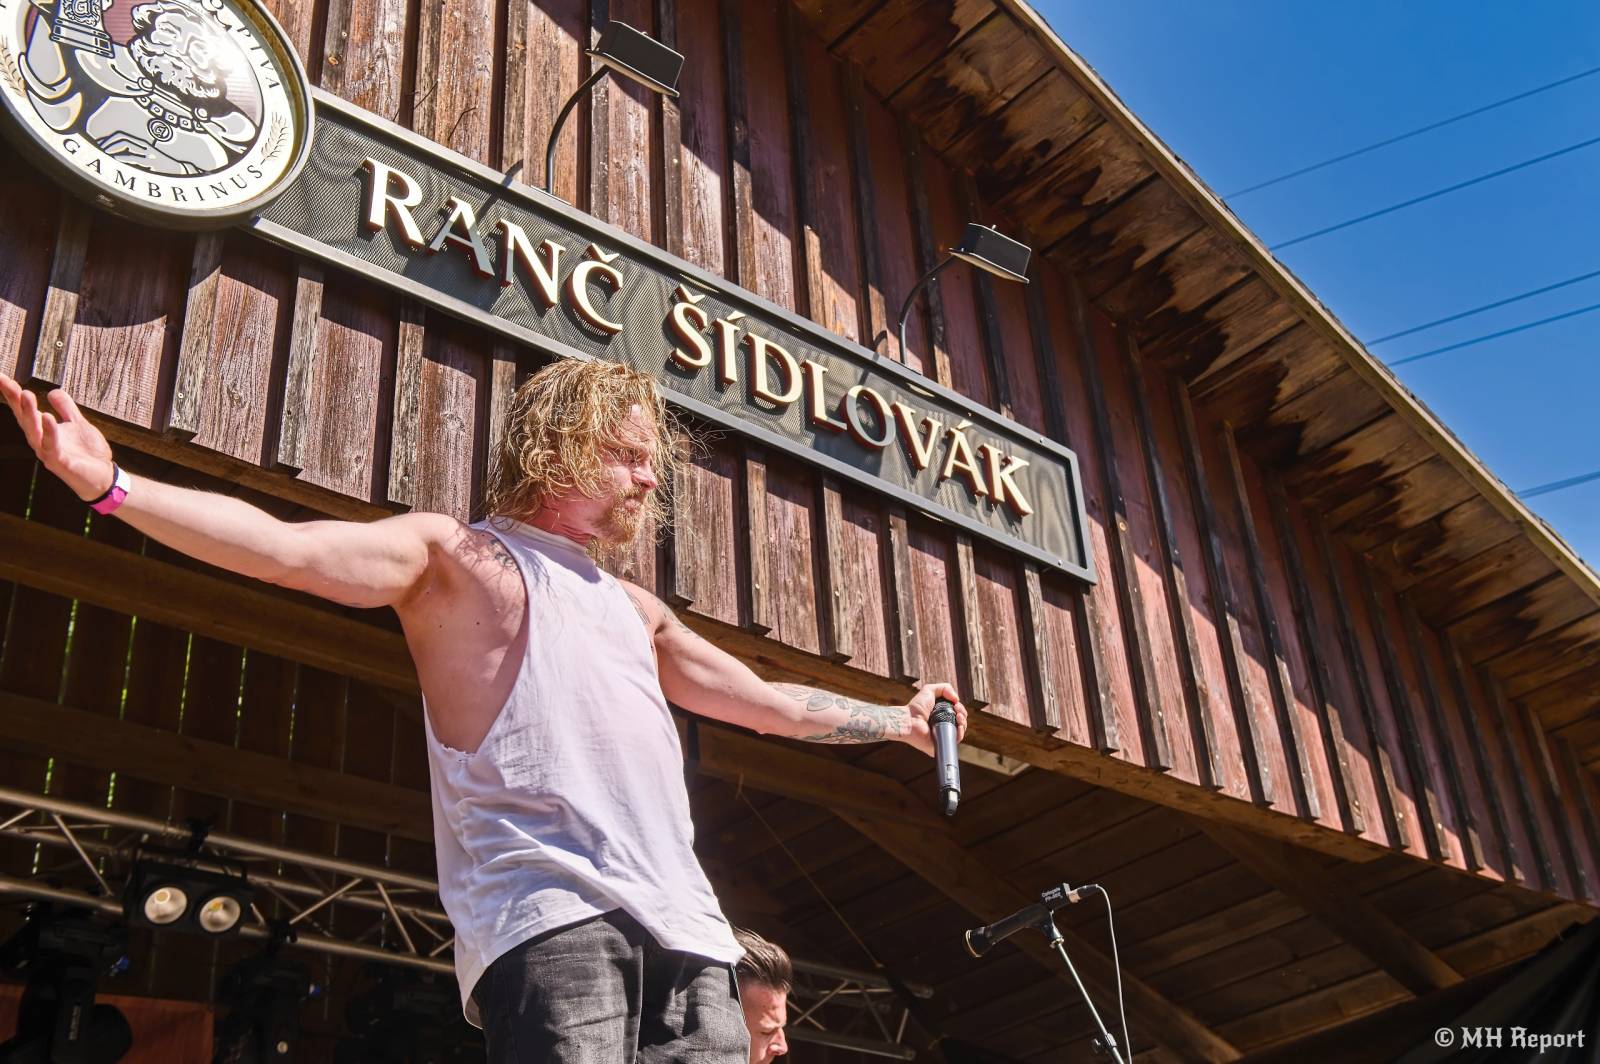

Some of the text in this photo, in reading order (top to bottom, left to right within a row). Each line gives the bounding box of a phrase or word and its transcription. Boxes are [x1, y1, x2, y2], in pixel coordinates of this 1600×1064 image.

[236, 26, 280, 89] PIVA
[63, 137, 264, 202] GAMBRINUS
[362, 156, 1033, 517] RANČ ŠÍDLOVÁK
